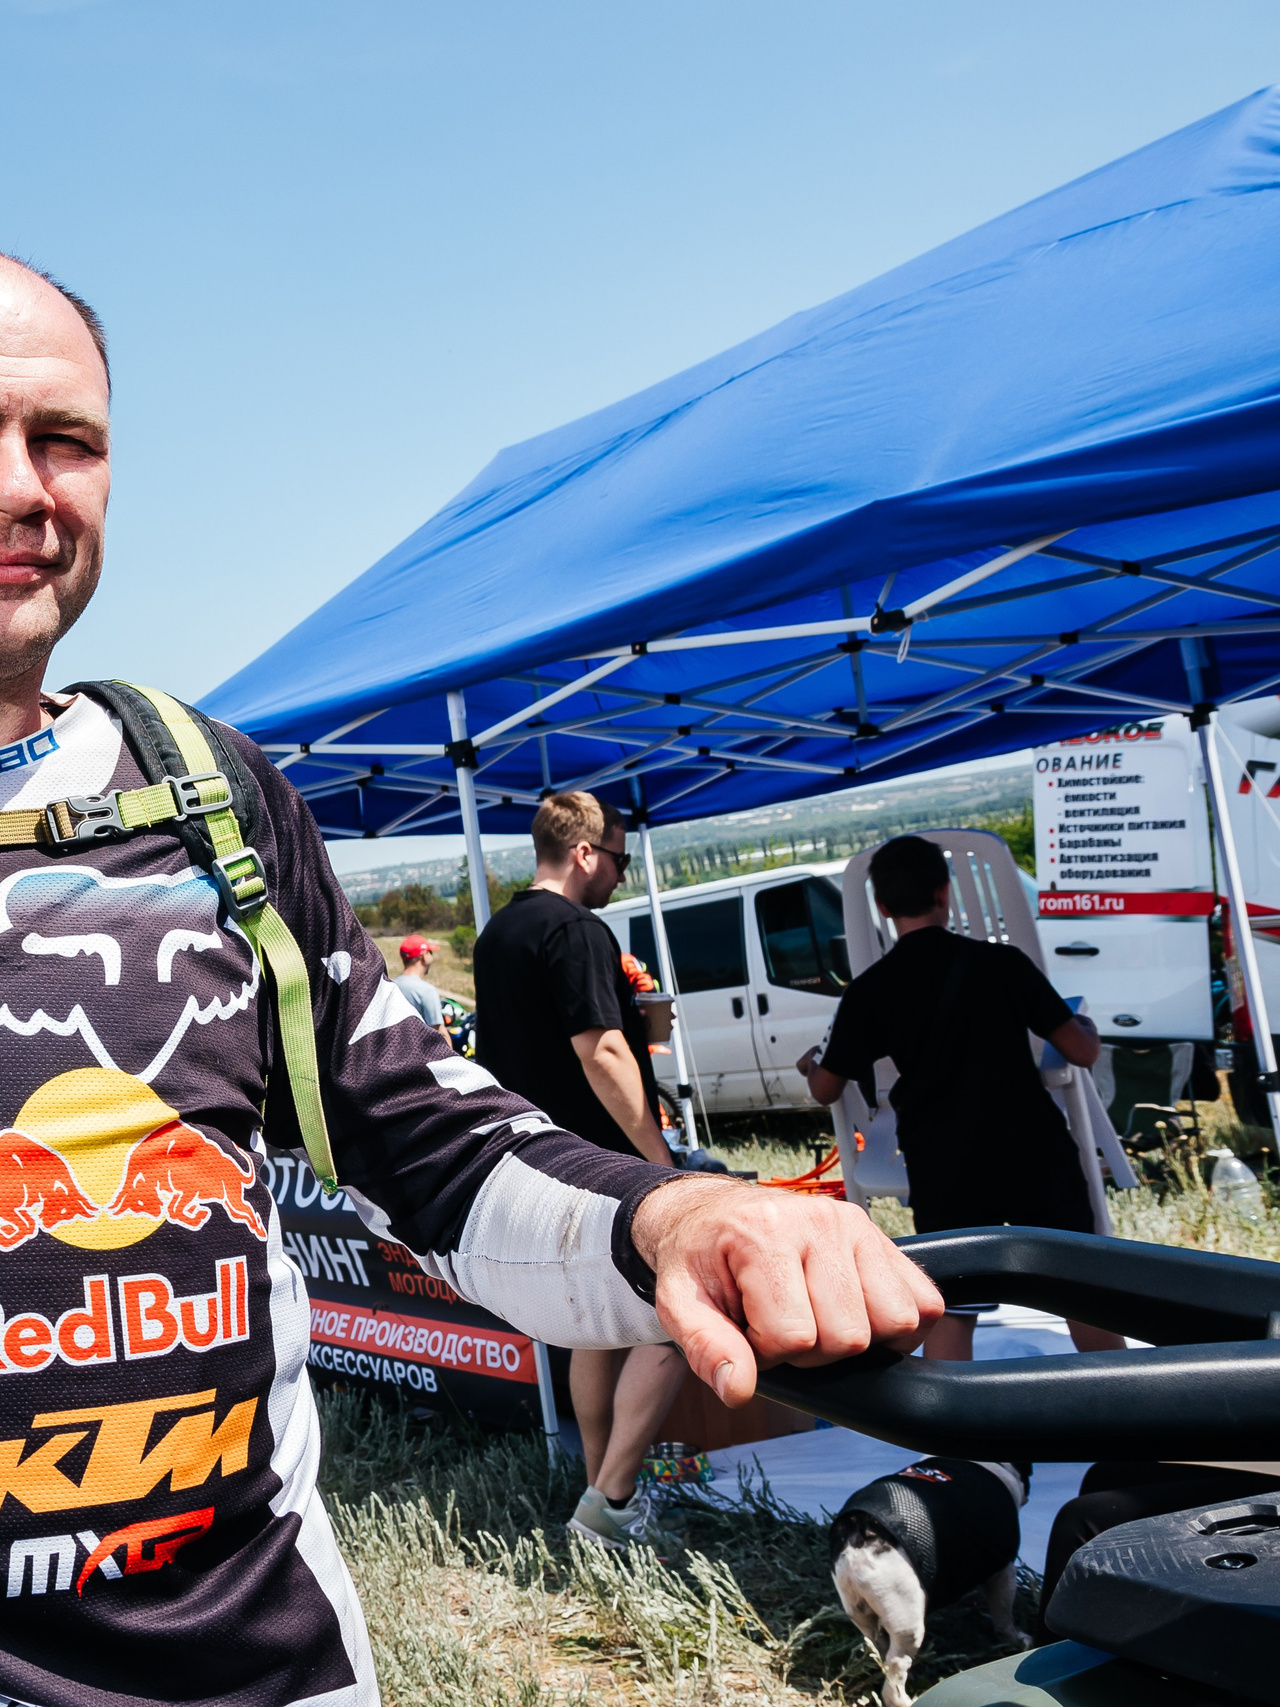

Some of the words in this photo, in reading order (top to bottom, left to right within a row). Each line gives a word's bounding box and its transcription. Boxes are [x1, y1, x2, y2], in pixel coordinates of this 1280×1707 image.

[1036, 753, 1123, 773] ОВАНИЕ
[1058, 822, 1124, 834] Источники
[1127, 820, 1186, 831] питания
[1058, 837, 1121, 849] Барабаны
[1059, 852, 1158, 864] Автоматизация
[1060, 868, 1151, 880] оборудования
[1039, 894, 1125, 911] rom161.ru
[117, 1255, 250, 1361] Bull
[350, 1316, 521, 1372] ПРОИЗВОДСТВО
[307, 1343, 438, 1393] КСЕССУАРОВ
